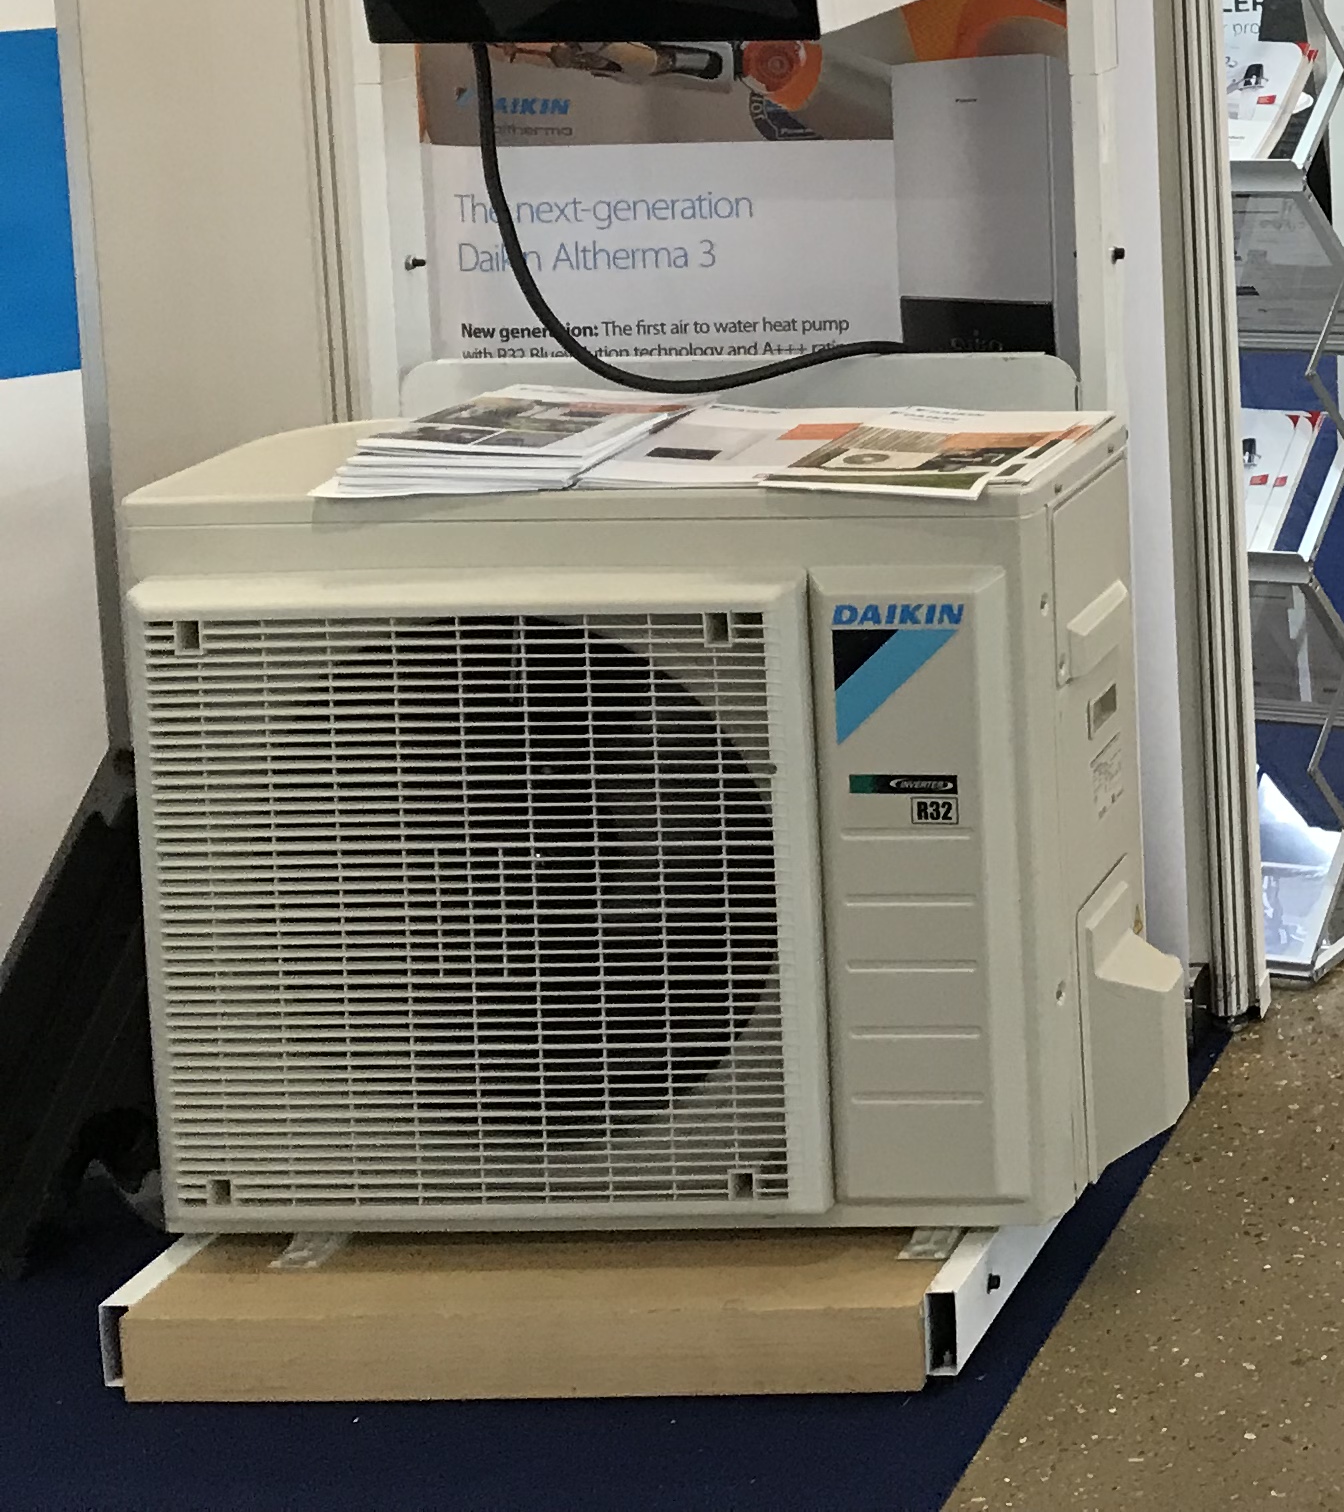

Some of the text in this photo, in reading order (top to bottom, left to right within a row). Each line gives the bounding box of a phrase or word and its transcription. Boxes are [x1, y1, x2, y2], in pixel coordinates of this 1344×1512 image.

[494, 97, 571, 115] AIKIN
[453, 191, 754, 230] The next-generation
[458, 239, 716, 274] Daikn Altherma 3
[461, 317, 850, 343] New generion: The first air to water heat pump
[725, 342, 758, 356] and
[831, 603, 964, 625] DAIKIN
[916, 801, 953, 820] R32
